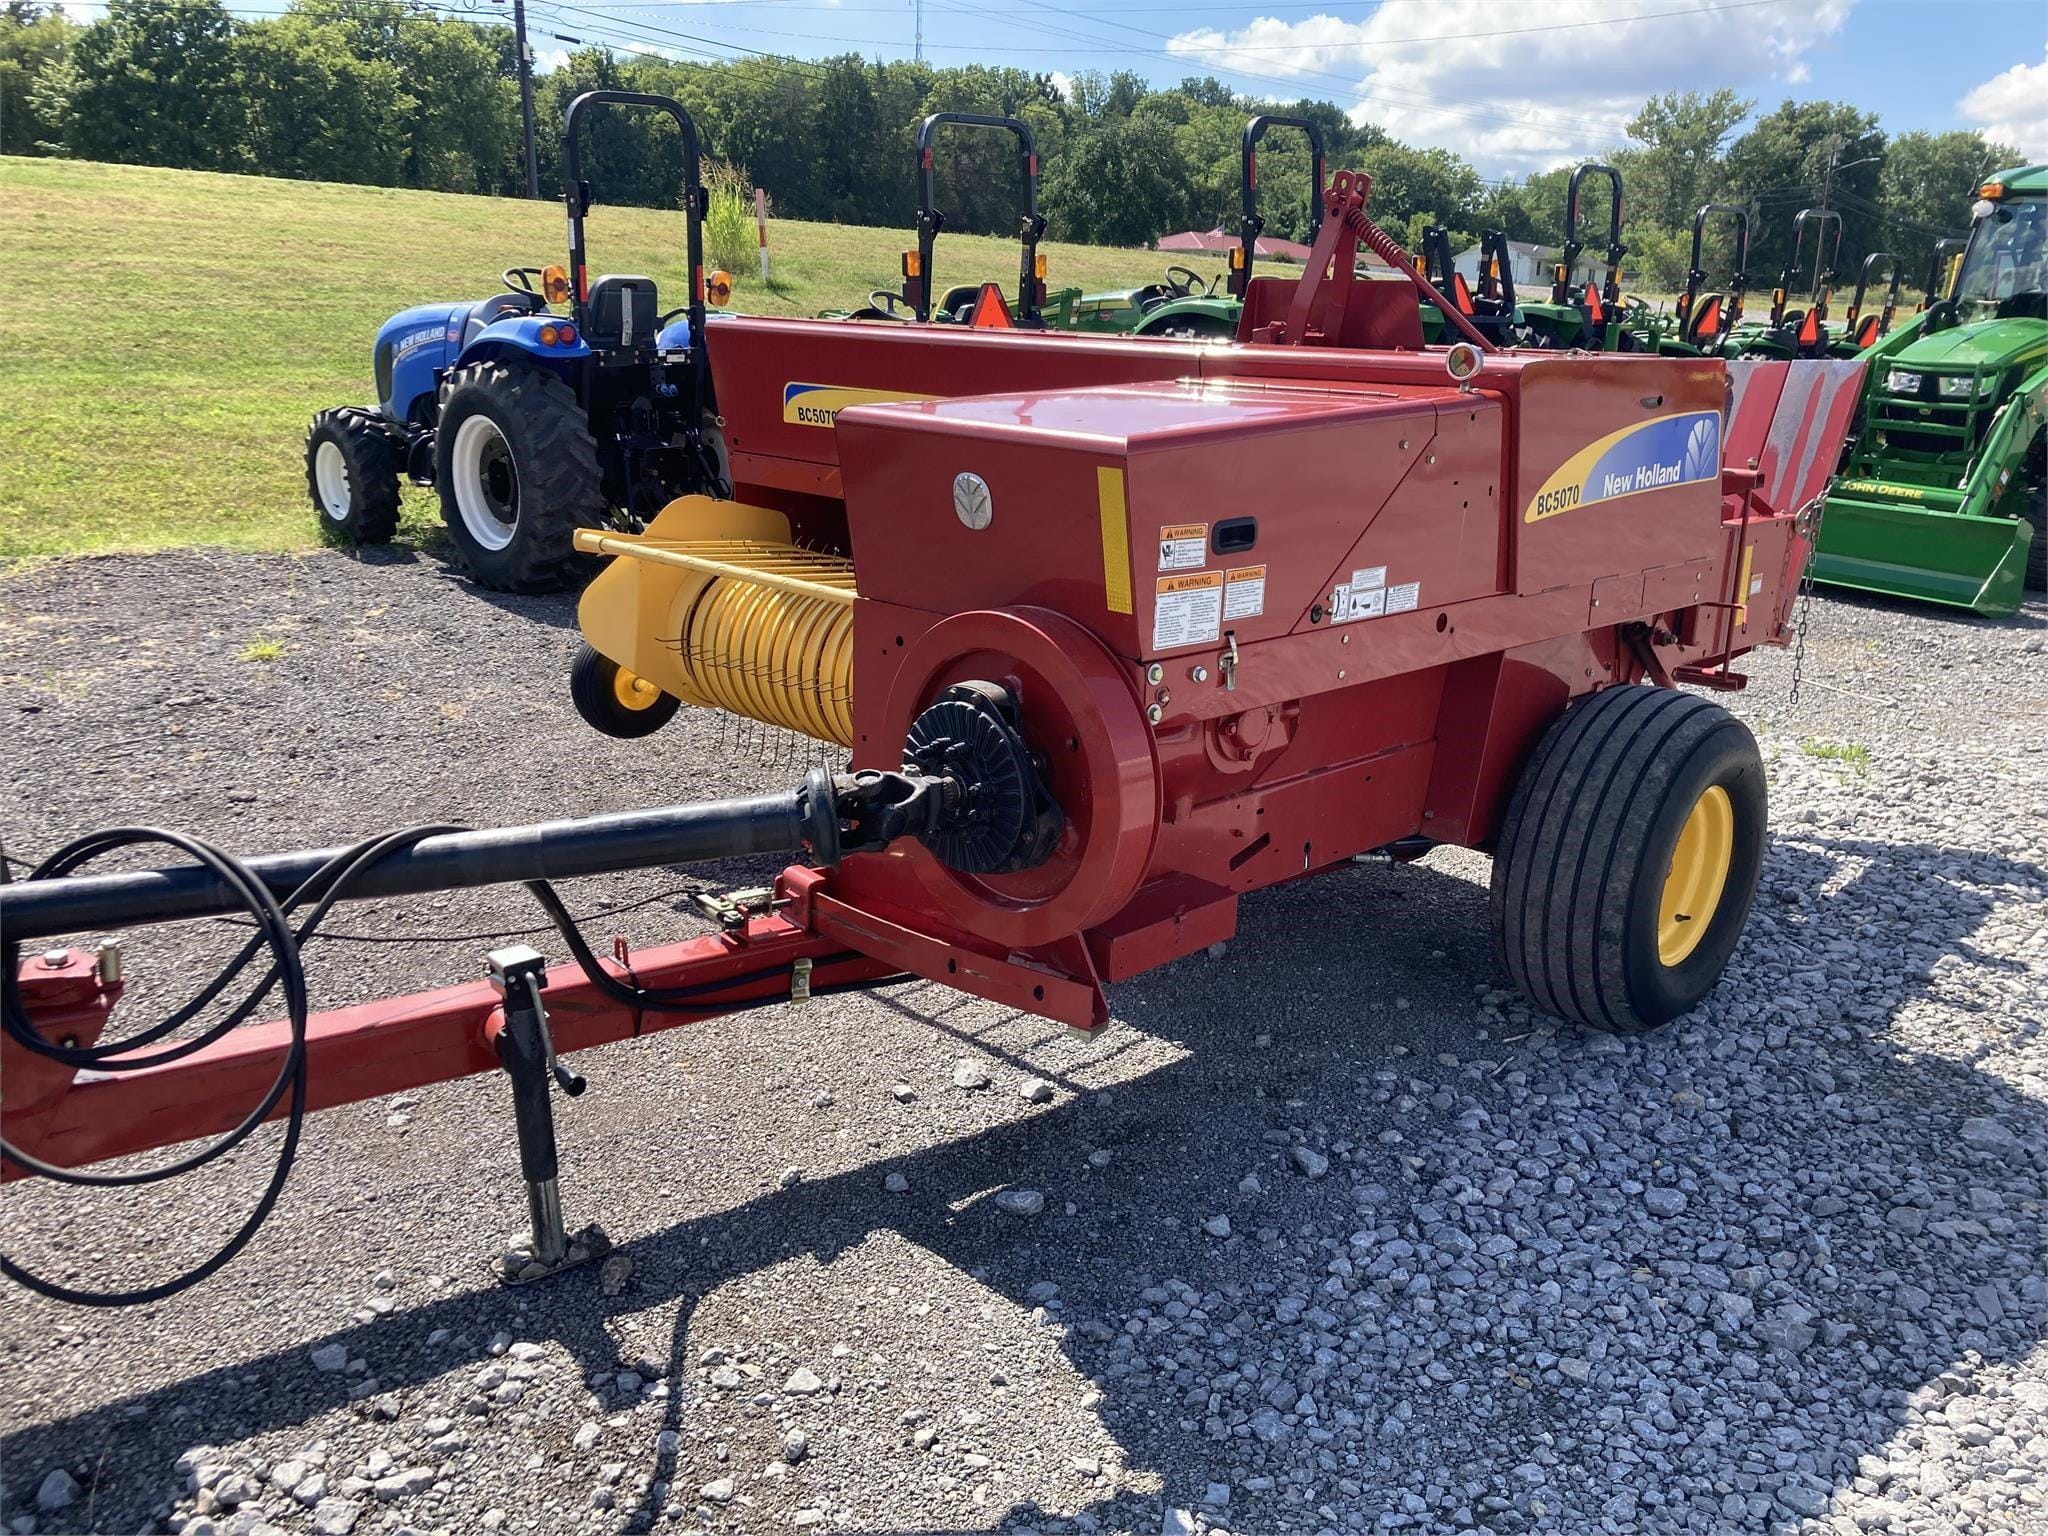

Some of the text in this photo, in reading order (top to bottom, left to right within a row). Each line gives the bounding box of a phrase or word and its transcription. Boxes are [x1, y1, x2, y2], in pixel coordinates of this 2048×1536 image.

[400, 335, 414, 351] NEW
[415, 326, 445, 342] HOLLAND
[1602, 460, 1682, 498] New Holland
[1840, 480, 1924, 498] JOHN DEERE
[1537, 484, 1580, 516] BC5070
[1174, 527, 1204, 537] WARNING
[1177, 576, 1212, 588] WARNING
[1236, 569, 1262, 579] WARNING
